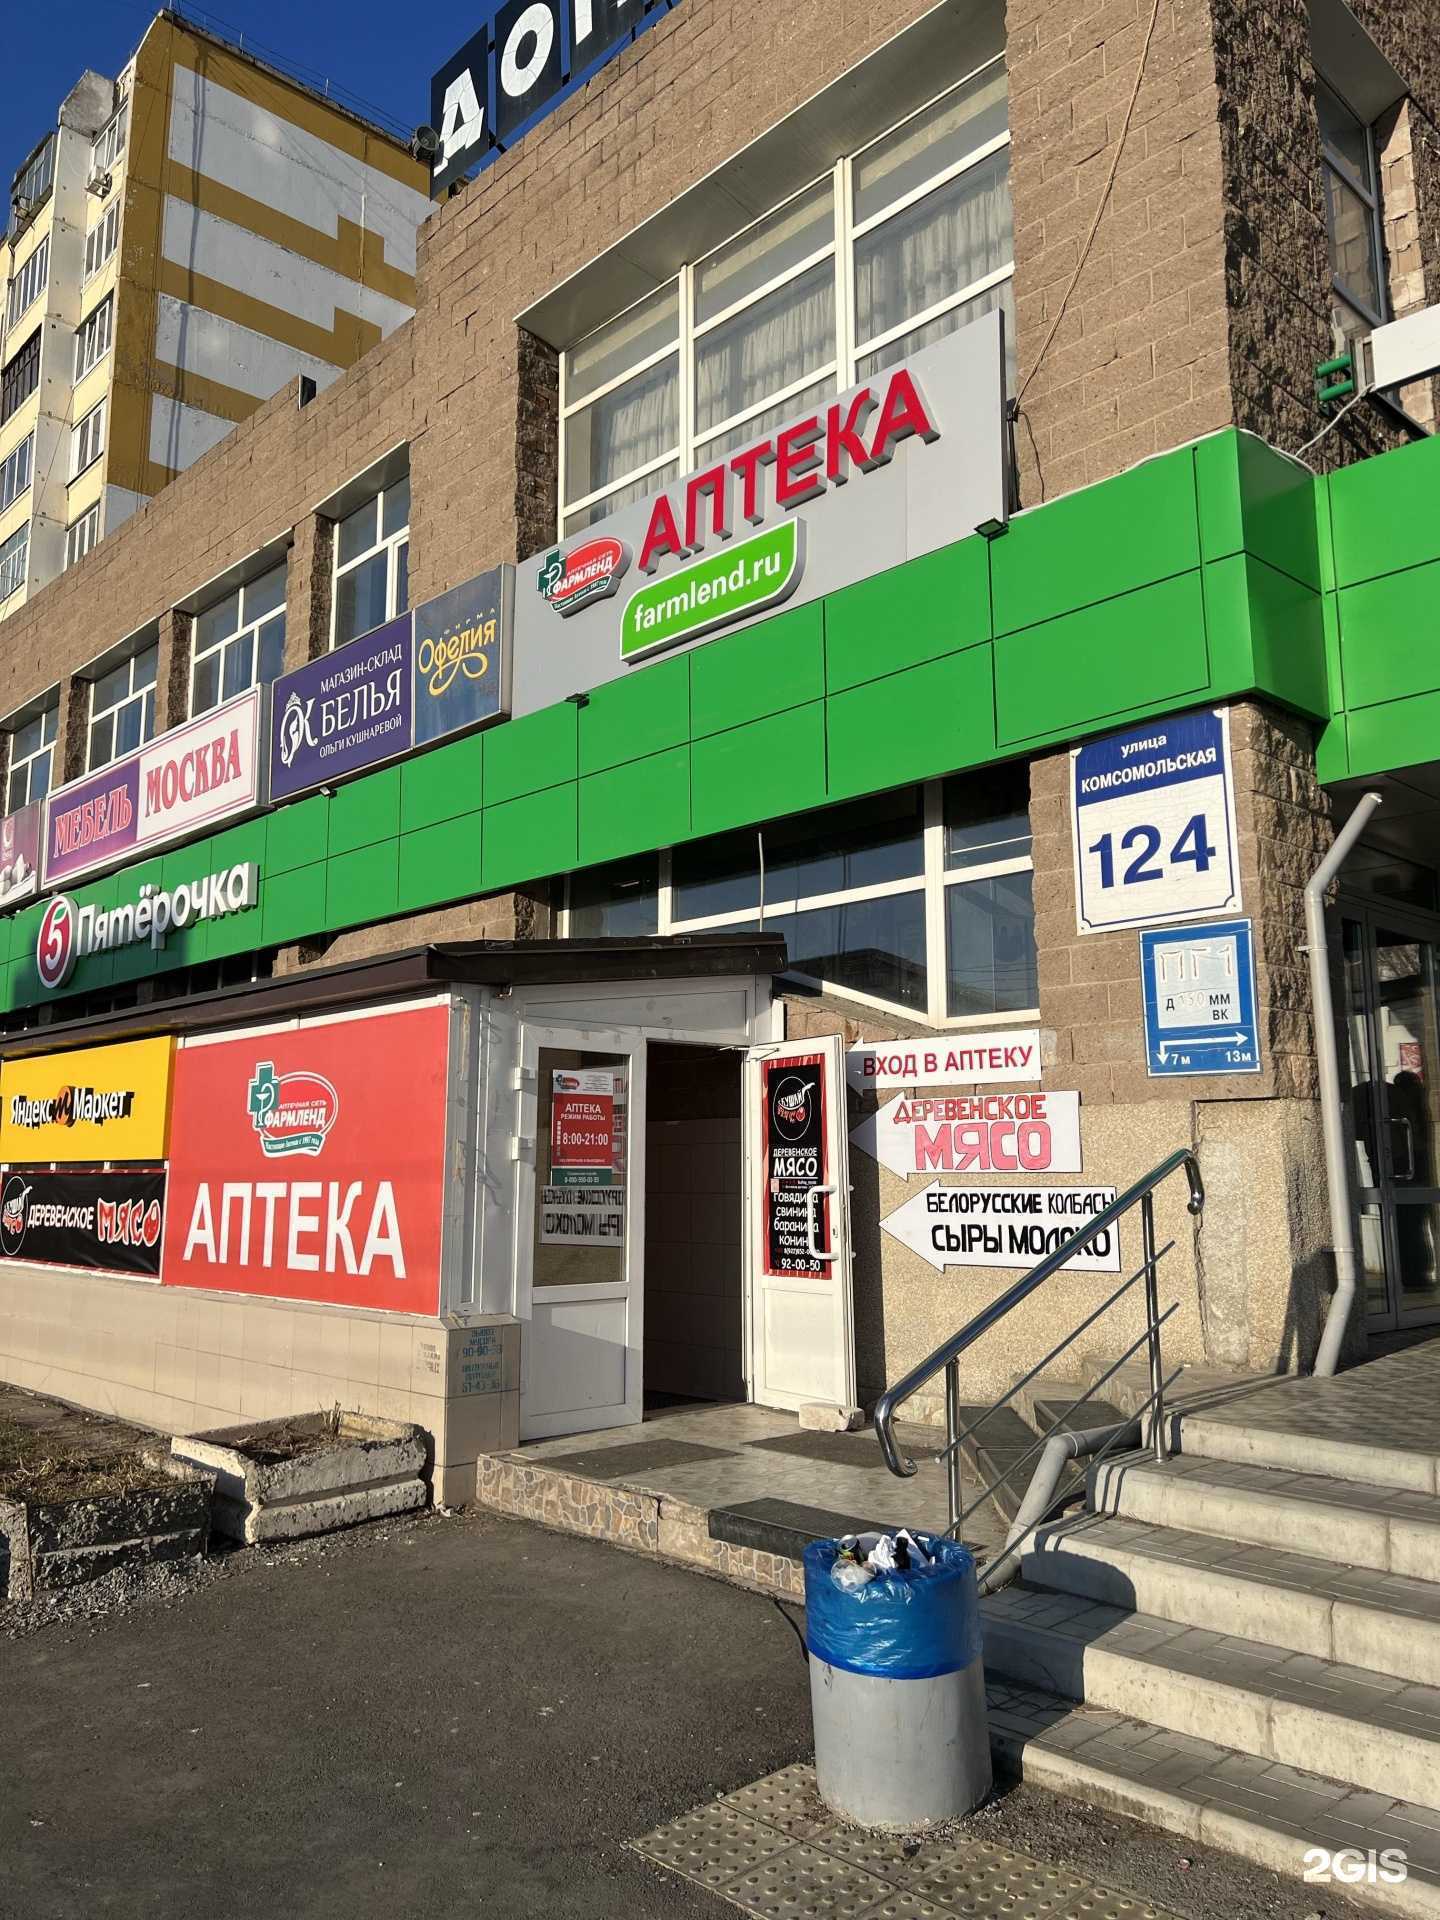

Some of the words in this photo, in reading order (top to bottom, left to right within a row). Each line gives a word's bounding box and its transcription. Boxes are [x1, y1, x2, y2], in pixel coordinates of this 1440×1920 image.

[638, 368, 938, 574] АПТЕКА
[552, 556, 613, 594] ФАРМЛЕНД
[634, 551, 781, 632] farmlend.ru
[320, 644, 402, 694] МАГАЗИН-СКЛАД
[418, 618, 497, 696] Офелия
[321, 668, 403, 737] БЕЛЬЯ
[320, 739, 345, 758] ОЛЬГИ
[346, 713, 402, 749] КУШНАРЕВОЙ
[1121, 734, 1167, 759] улица
[1081, 747, 1217, 794] КОМСОМОЛЬСКАЯ
[53, 783, 133, 858] МЕБЕЛЬ
[145, 729, 242, 818] МОСКВА
[1089, 813, 1216, 889] 124
[77, 862, 253, 950] Пятёрочка
[863, 1055, 918, 1078] ВХОД
[924, 1053, 938, 1072] В
[945, 1046, 1033, 1072] АПТЕКУ
[10, 1094, 53, 1126] Яндекс
[72, 1088, 127, 1124] Маркет
[264, 1108, 327, 1128] ФАРМЛЕНД
[565, 1103, 601, 1113] АПТЕКА
[893, 1094, 1047, 1125] ДЕРЕВЕНСКОЕ
[562, 1132, 608, 1145] 8:00-21:00
[773, 1147, 817, 1157] ДЕРЕВЕНСКОЕ
[915, 1121, 1052, 1171] МЯСО
[774, 1157, 818, 1177] МЯСО
[773, 1192, 818, 1204] говядиа
[926, 1193, 1042, 1214] БЕЛОРУССКИЕ
[27, 1204, 94, 1230] ДЕРЕВЕНСКОЕ
[97, 1198, 161, 1247] МЯСО
[182, 1180, 406, 1279] АПТЕКА
[774, 1217, 819, 1235] бараниа
[779, 1235, 810, 1247] конин
[931, 1224, 1002, 1253] СЫРЫ
[781, 1258, 820, 1271] 92-00-50
